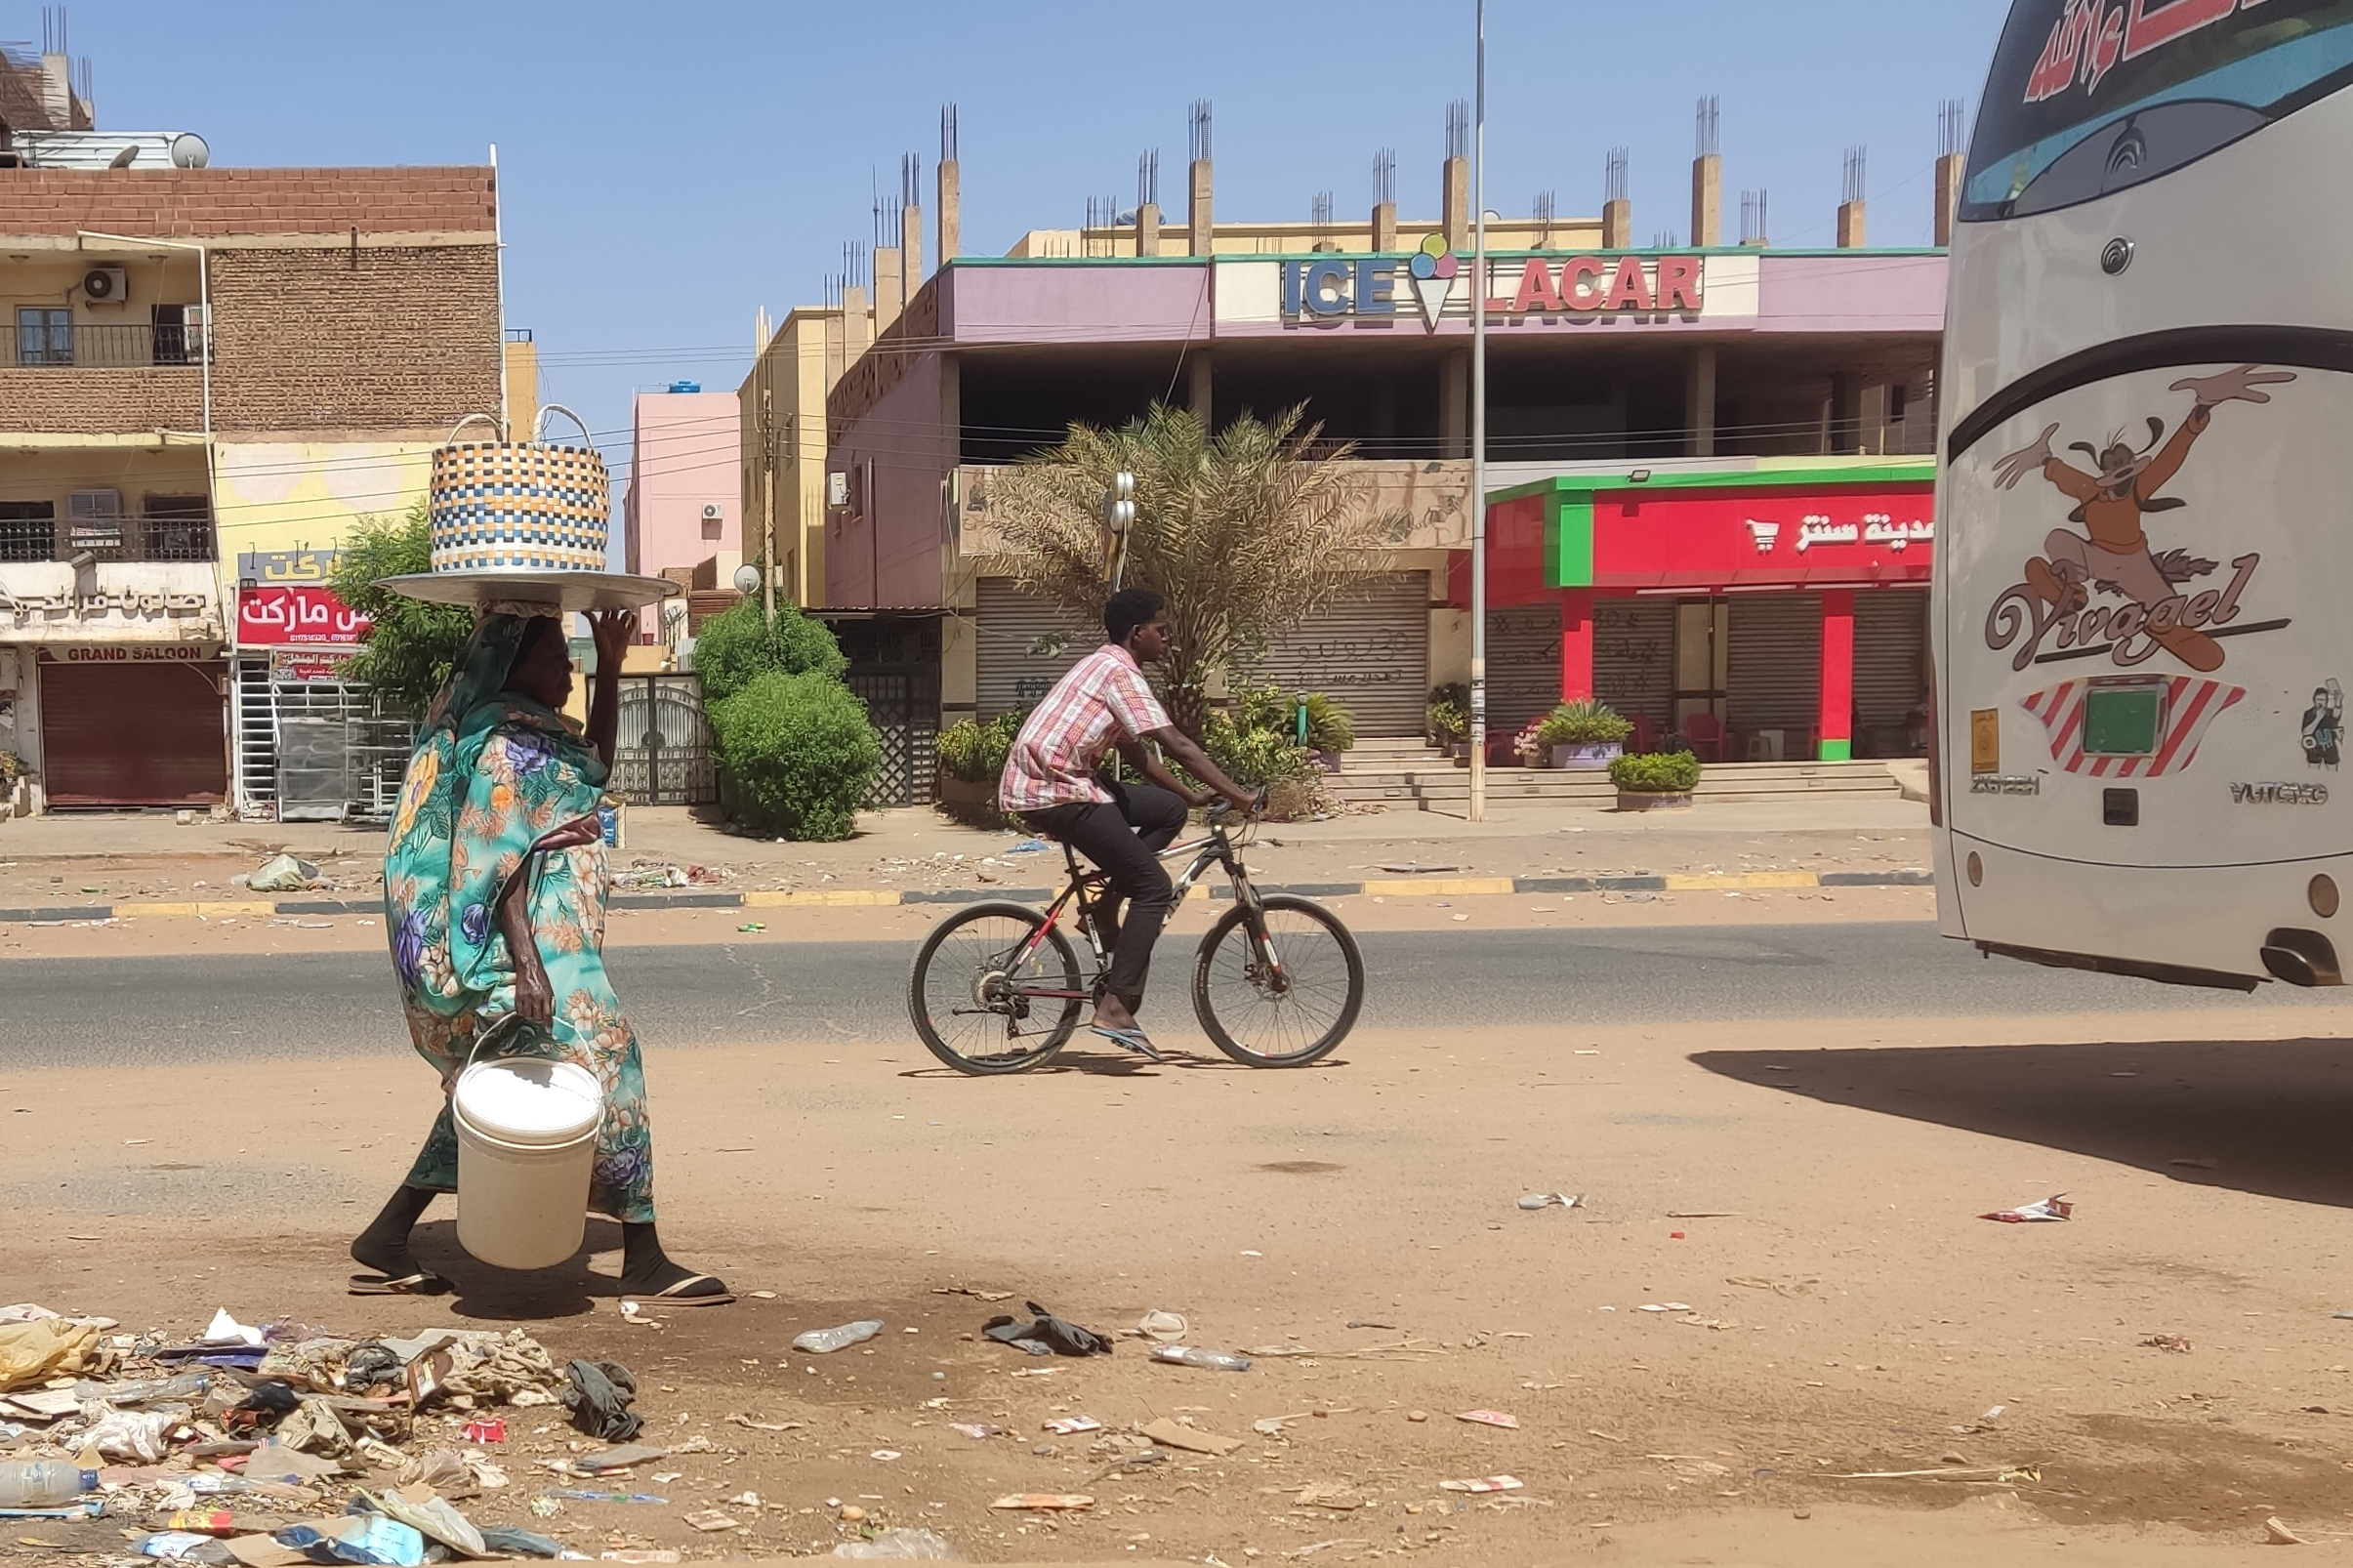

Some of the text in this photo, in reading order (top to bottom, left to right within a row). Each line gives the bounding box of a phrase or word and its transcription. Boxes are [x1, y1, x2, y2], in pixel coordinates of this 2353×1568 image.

[1284, 255, 1704, 315] ICE LACAR
[1796, 514, 1859, 554] سنتر
[119, 586, 202, 614] صالون
[242, 595, 329, 633] ماركت
[67, 646, 201, 661] GRAND SALOON
